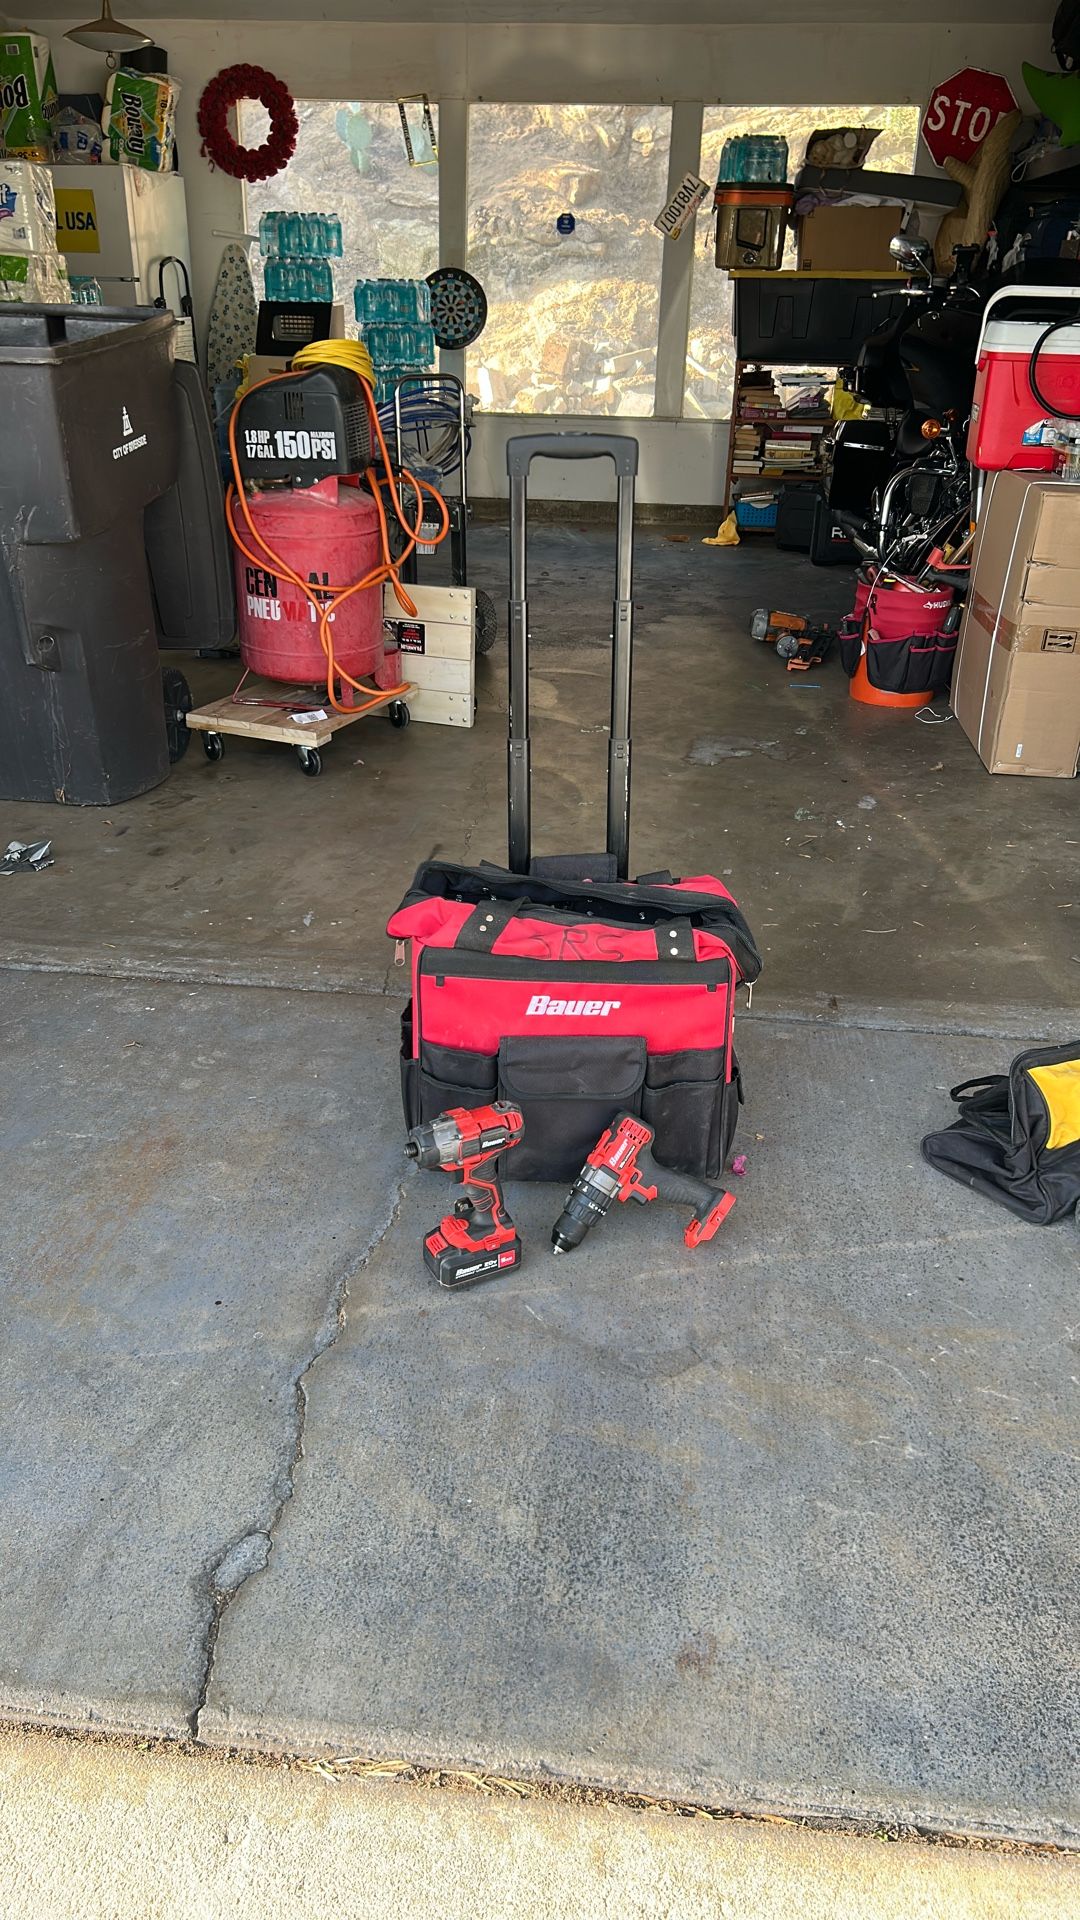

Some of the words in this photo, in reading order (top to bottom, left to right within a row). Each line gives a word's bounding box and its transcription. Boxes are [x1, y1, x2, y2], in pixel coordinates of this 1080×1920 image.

[927, 95, 1008, 142] STO
[660, 178, 700, 232] 7V81007
[65, 211, 97, 231] USA
[244, 429, 257, 444] 1.8
[257, 430, 270, 444] HP
[274, 430, 311, 460] 150
[112, 446, 123, 460] CITY
[122, 443, 129, 455] OF
[245, 444, 256, 459] 17
[256, 444, 276, 459] GAL
[311, 438, 337, 460] PSI
[246, 566, 335, 600] CENAL
[525, 995, 622, 1017] Bauer
[481, 1137, 506, 1149] Bauer
[608, 1138, 629, 1167] Bauer
[455, 1263, 483, 1277] Bauer
